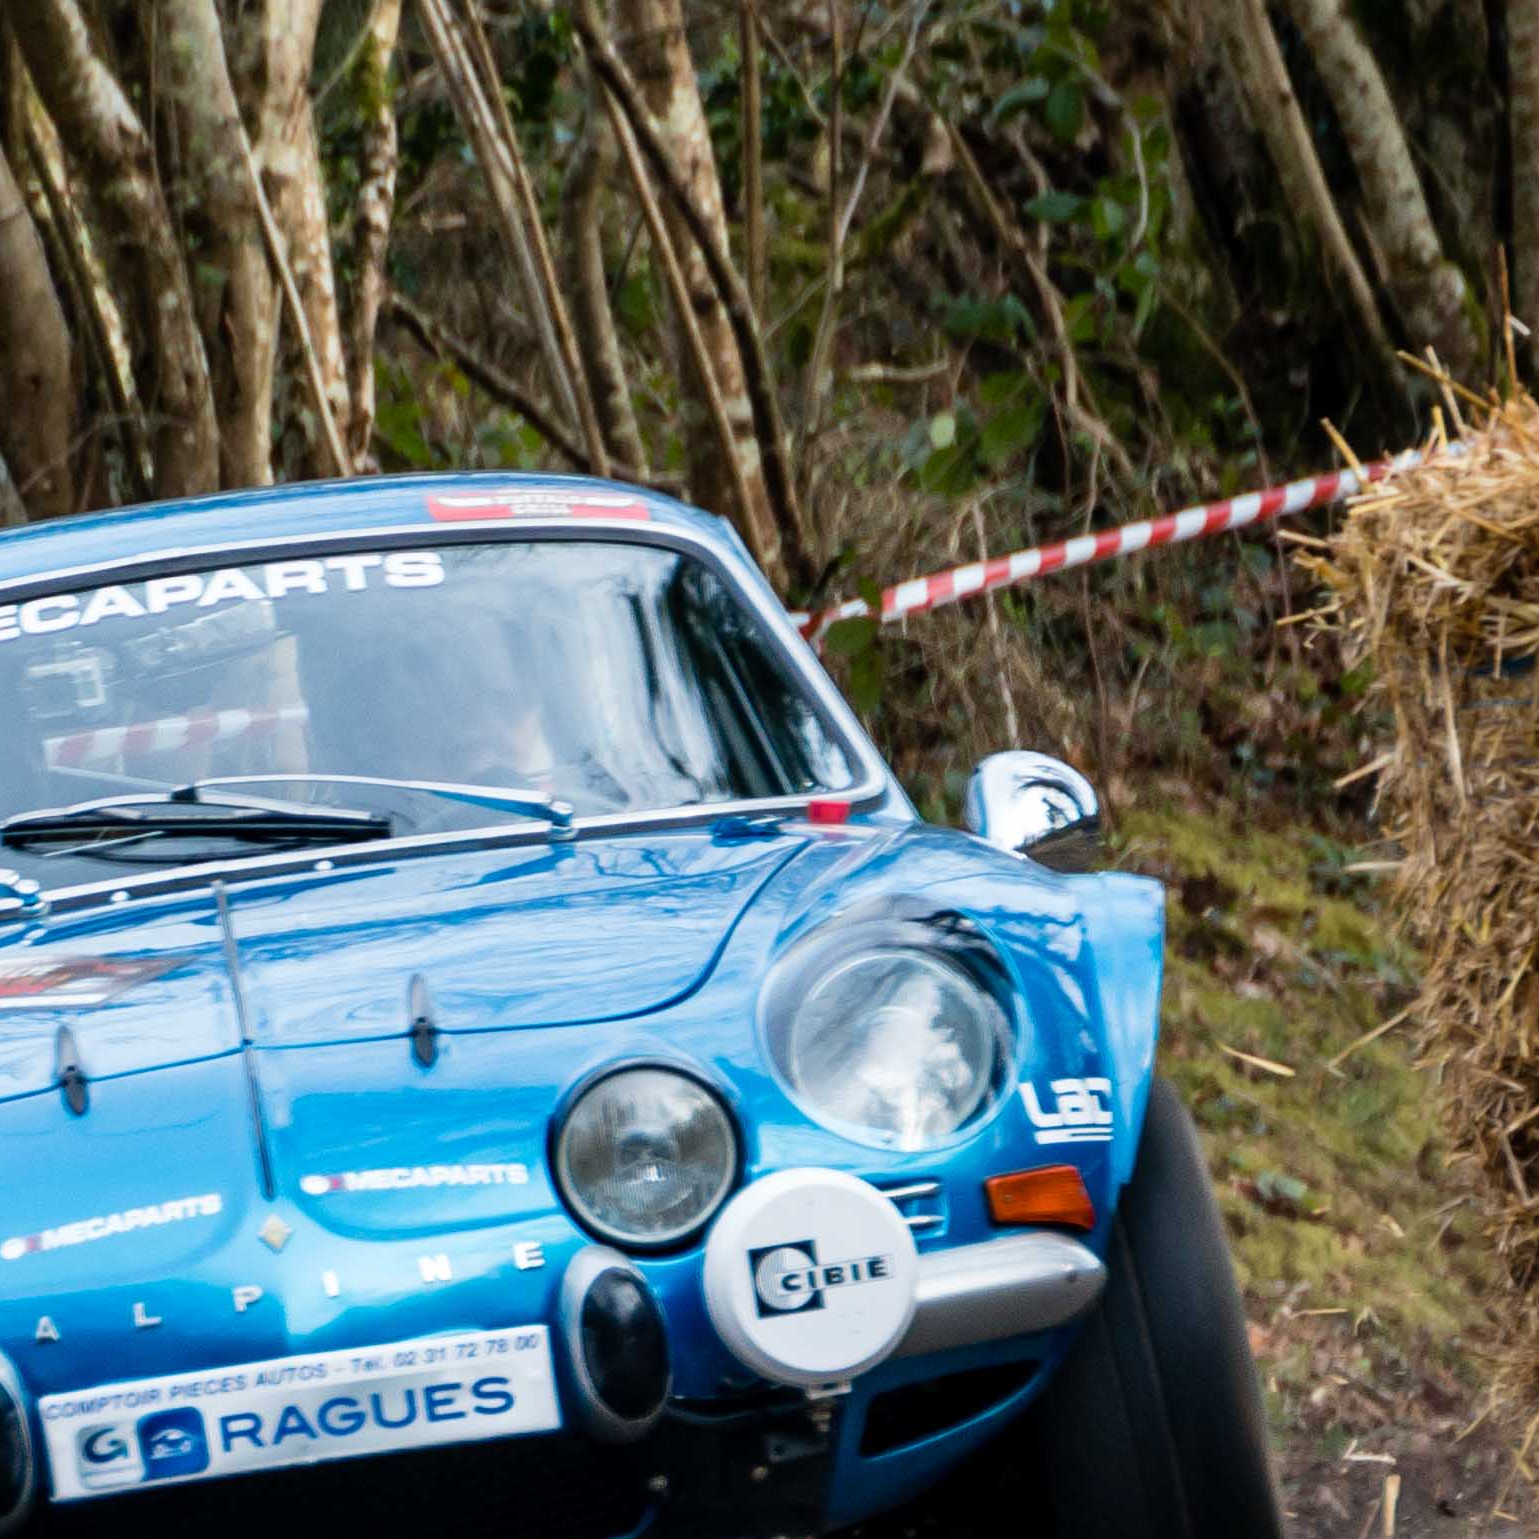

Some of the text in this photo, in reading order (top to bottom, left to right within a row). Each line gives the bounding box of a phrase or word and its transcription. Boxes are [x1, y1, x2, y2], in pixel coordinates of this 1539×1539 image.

[344, 1164, 529, 1191] MECAPARTS
[41, 1193, 222, 1250] MECAPARTS
[44, 1387, 161, 1421] COMPTOIR
[254, 1362, 328, 1387] AUTOS
[392, 1350, 416, 1368] 02
[424, 1346, 446, 1364] 31
[455, 1341, 478, 1359] 72
[485, 1338, 509, 1355] 78
[219, 1376, 515, 1453] RAGUES
